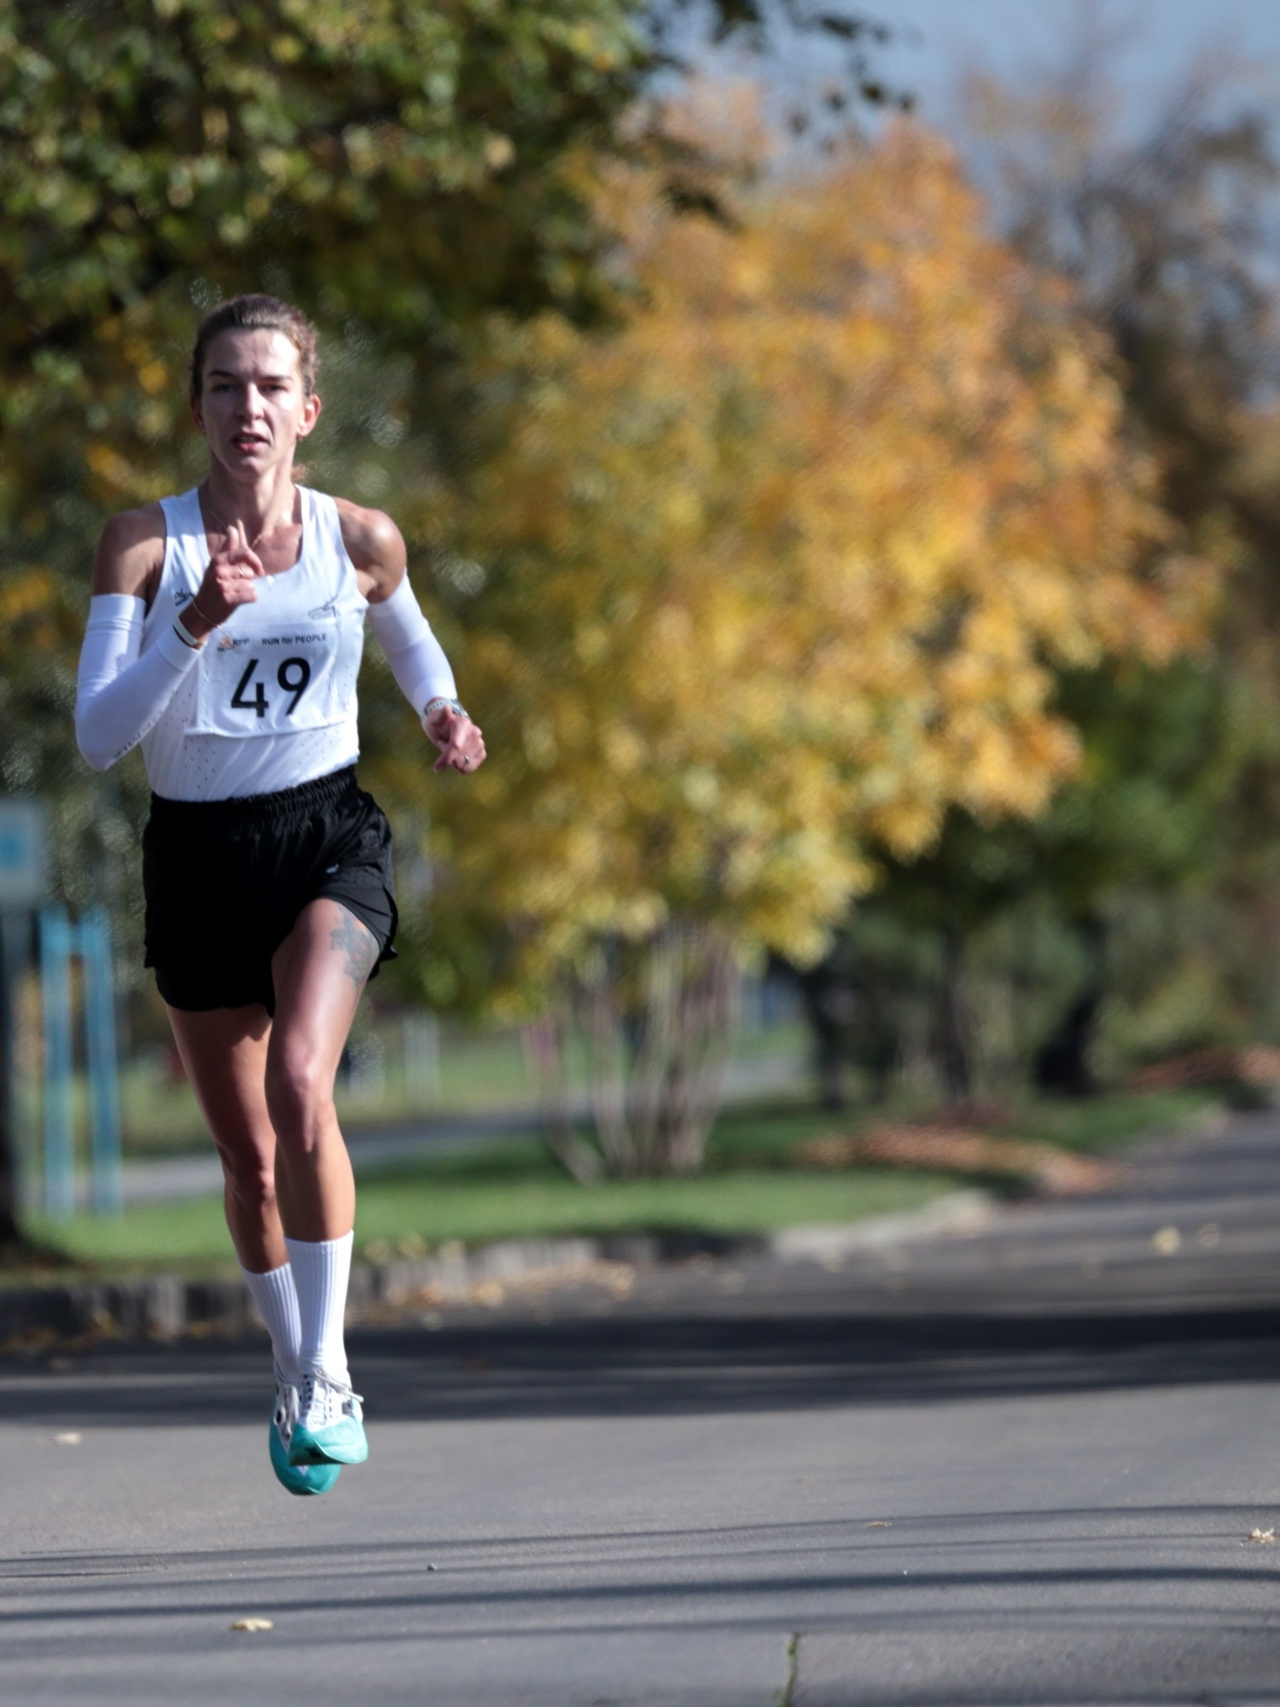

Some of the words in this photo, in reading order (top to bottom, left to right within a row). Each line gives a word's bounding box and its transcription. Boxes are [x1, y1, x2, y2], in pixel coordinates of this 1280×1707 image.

[262, 637, 279, 646] RUN
[282, 636, 293, 645] for
[295, 633, 327, 644] PEOPLE
[231, 657, 311, 718] 49
